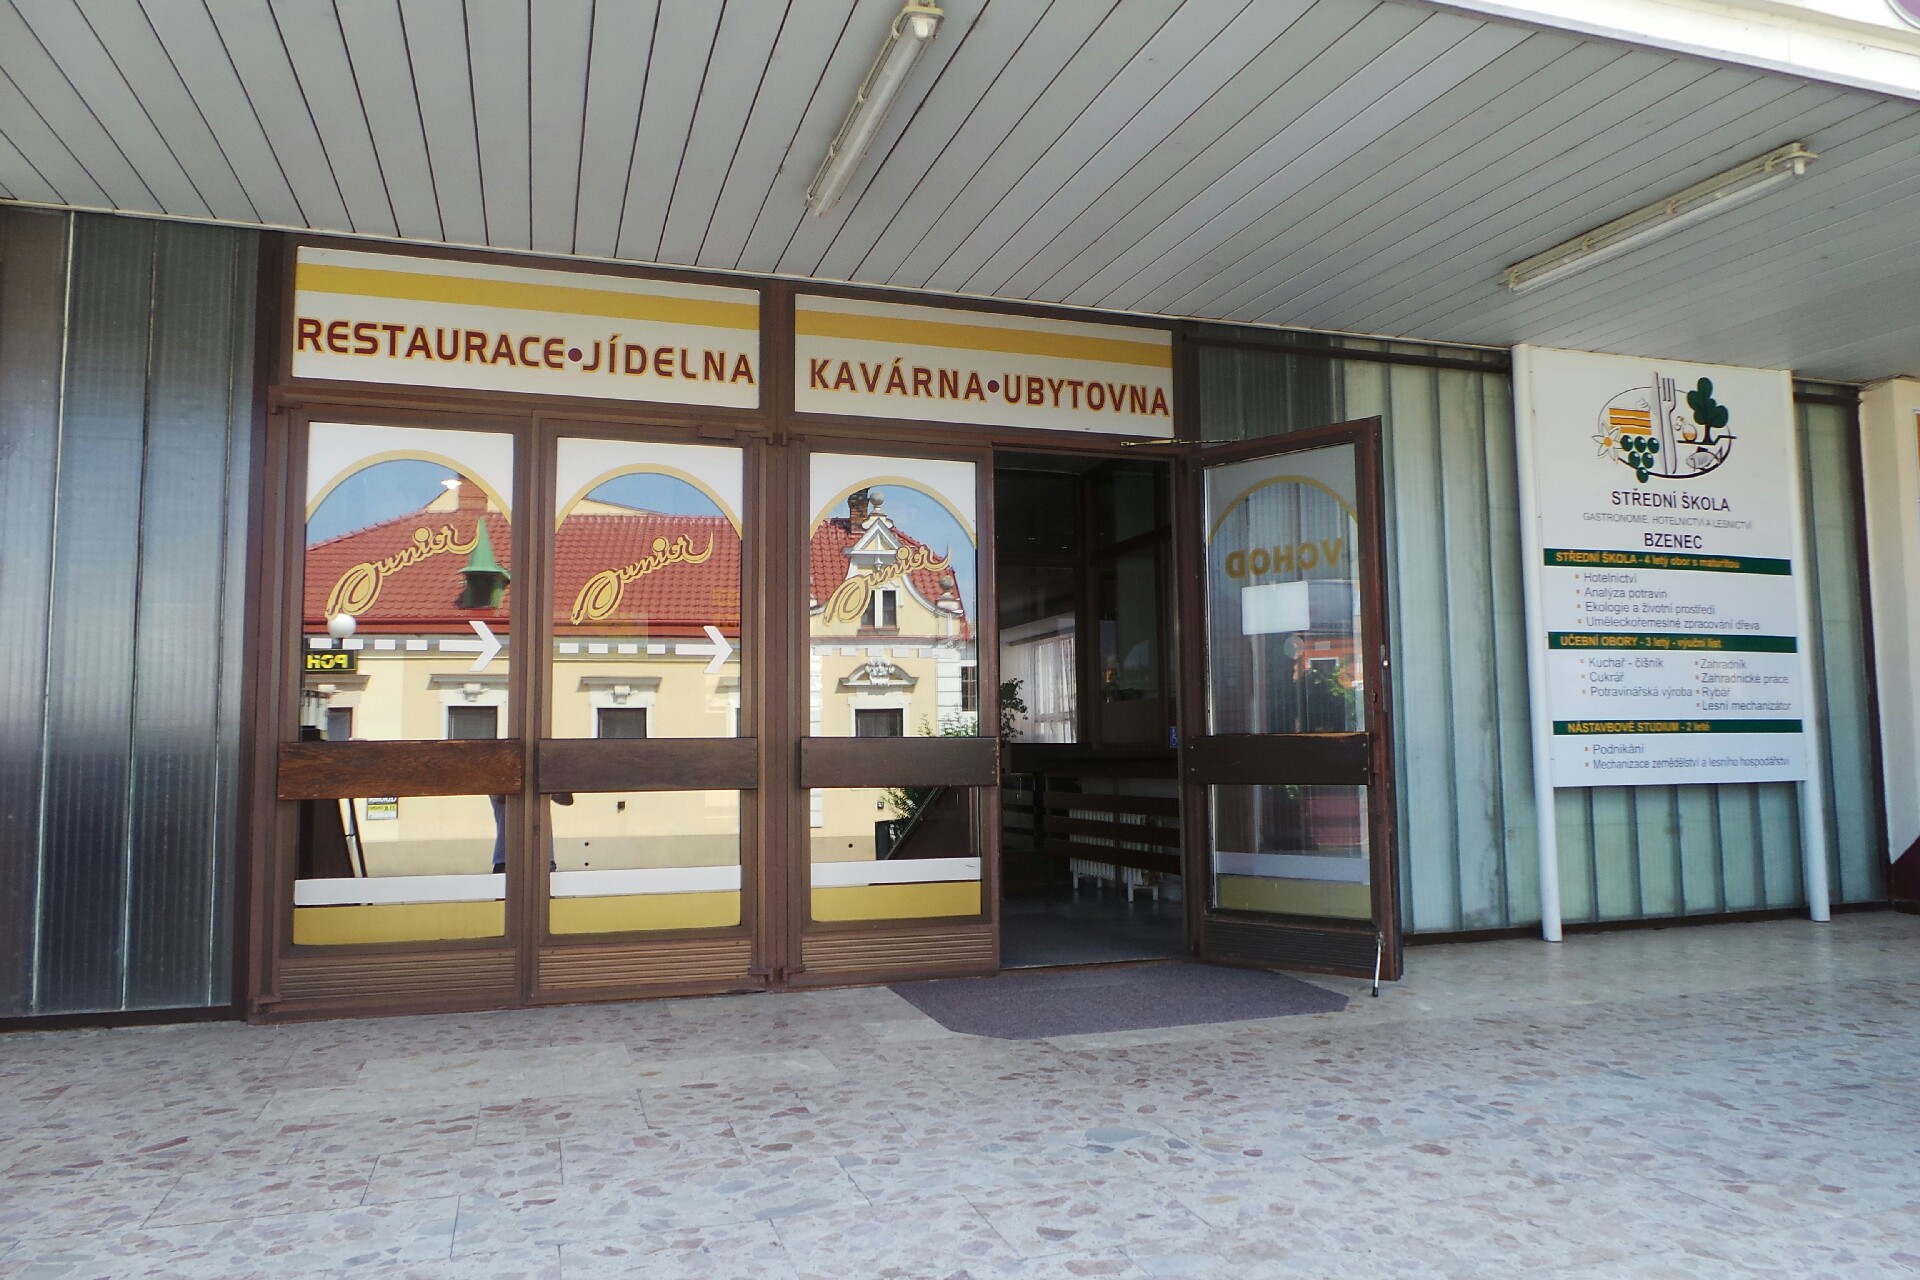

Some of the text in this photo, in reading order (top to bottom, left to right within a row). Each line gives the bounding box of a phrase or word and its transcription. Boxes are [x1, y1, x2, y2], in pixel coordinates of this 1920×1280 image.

[296, 315, 756, 385] RESTAURACE JÍDELNA
[809, 356, 1171, 418] KAVÁRNA UBYTOVNA
[1611, 488, 1730, 512] STŘEDNÍ ŠKOLA
[1644, 533, 1703, 549] BZENEC
[1556, 551, 1600, 562] STŘEDNÍ
[1601, 552, 1637, 563] ŠKOLA
[1584, 572, 1637, 583] Hotelnictví
[1584, 587, 1667, 600] Analýza potravin
[1586, 601, 1629, 615] Ekologie
[1736, 619, 1760, 630] dřeva
[1561, 634, 1599, 646] UČEBNÍ
[1601, 636, 1638, 646] OBORY
[1589, 657, 1625, 668] Kuchař
[1590, 671, 1624, 682] Cukrář
[1763, 674, 1789, 684] práce
[1661, 687, 1692, 699] výroba
[1702, 687, 1731, 699] Rybář
[1702, 700, 1729, 711] Lesní
[1638, 722, 1679, 732] STUDIUM
[1593, 744, 1644, 754] Podnikání
[1593, 759, 1650, 769] Mechanizace
